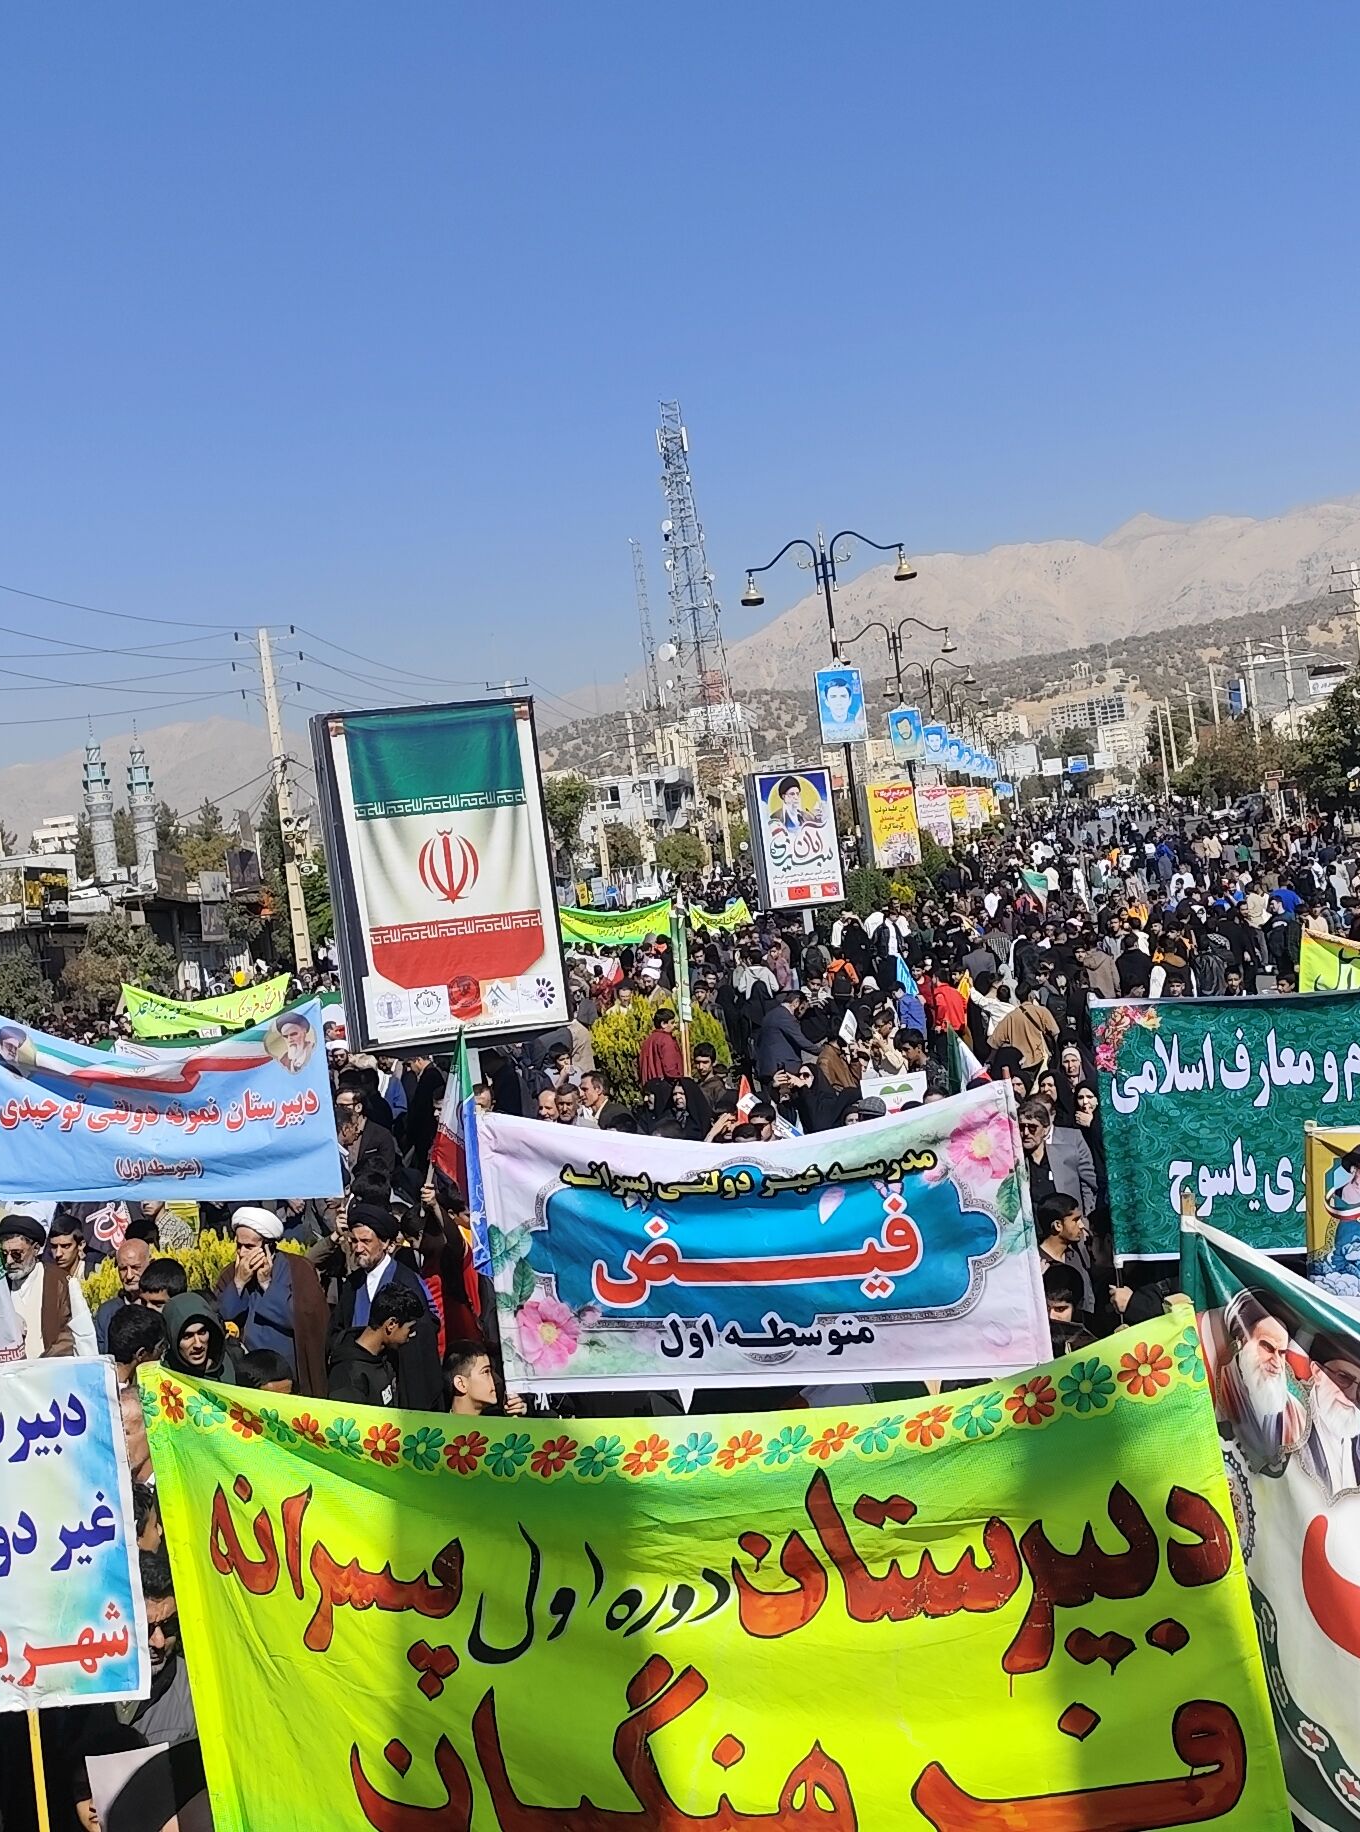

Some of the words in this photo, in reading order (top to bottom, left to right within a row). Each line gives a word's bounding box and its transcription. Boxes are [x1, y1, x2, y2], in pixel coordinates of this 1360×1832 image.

[1111, 1033, 1214, 1114] اسلامی
[1220, 1029, 1315, 1107] معارف
[1322, 1058, 1338, 1103] و
[0, 1093, 86, 1131] توحیدی
[89, 1099, 160, 1135] دولتی
[166, 1098, 222, 1134] نمونه
[225, 1088, 320, 1134] دبیرستان
[561, 1161, 652, 1202] پسرانه
[656, 1169, 751, 1201] دولتی
[761, 1164, 822, 1199] غیر
[827, 1149, 936, 1184] مدرسه
[592, 1193, 925, 1308] فیض
[660, 1318, 714, 1359] اول
[723, 1318, 875, 1355] متوسطه
[51, 1492, 117, 1572] غیر
[209, 1472, 465, 1700] پسرانه
[467, 1520, 605, 1665] اول
[731, 1466, 1233, 1680] دبیرستان
[607, 1557, 731, 1636] دوره
[349, 1653, 1247, 1832] فرهنگیان
